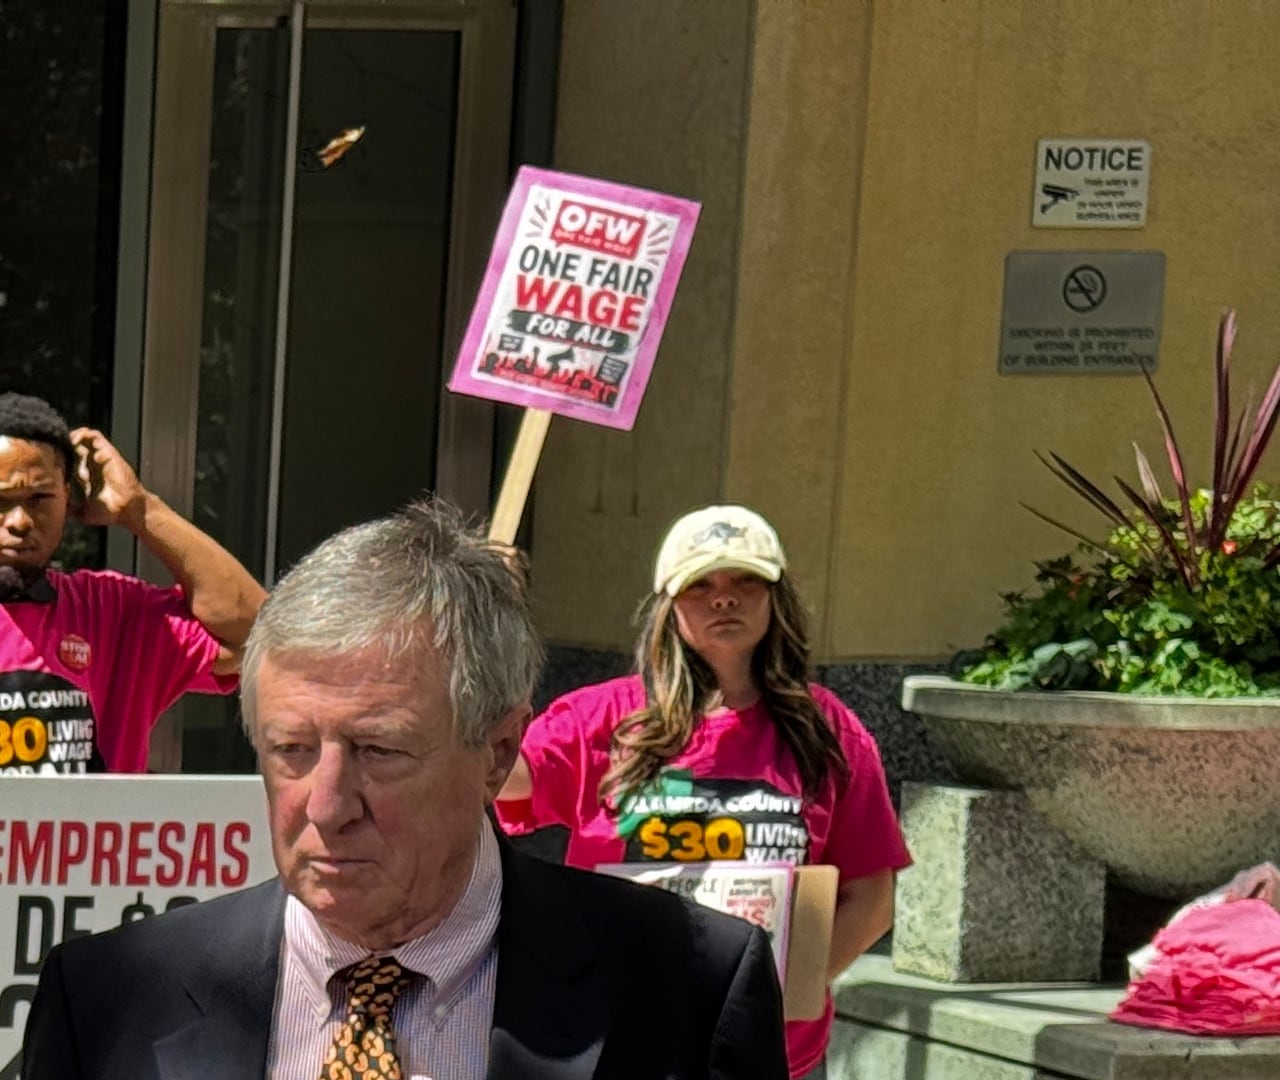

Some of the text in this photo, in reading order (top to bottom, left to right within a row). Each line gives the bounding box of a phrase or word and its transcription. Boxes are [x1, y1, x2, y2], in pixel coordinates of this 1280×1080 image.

[1044, 147, 1144, 171] NOTICE
[560, 205, 641, 245] OFW
[519, 245, 654, 296] ONE FAIR
[516, 273, 649, 332] WAGE
[526, 316, 616, 349] FOR ALL
[27, 690, 88, 709] COUNTY
[47, 718, 94, 741] LIVING
[48, 742, 93, 762] WAGE
[641, 817, 744, 861] $30
